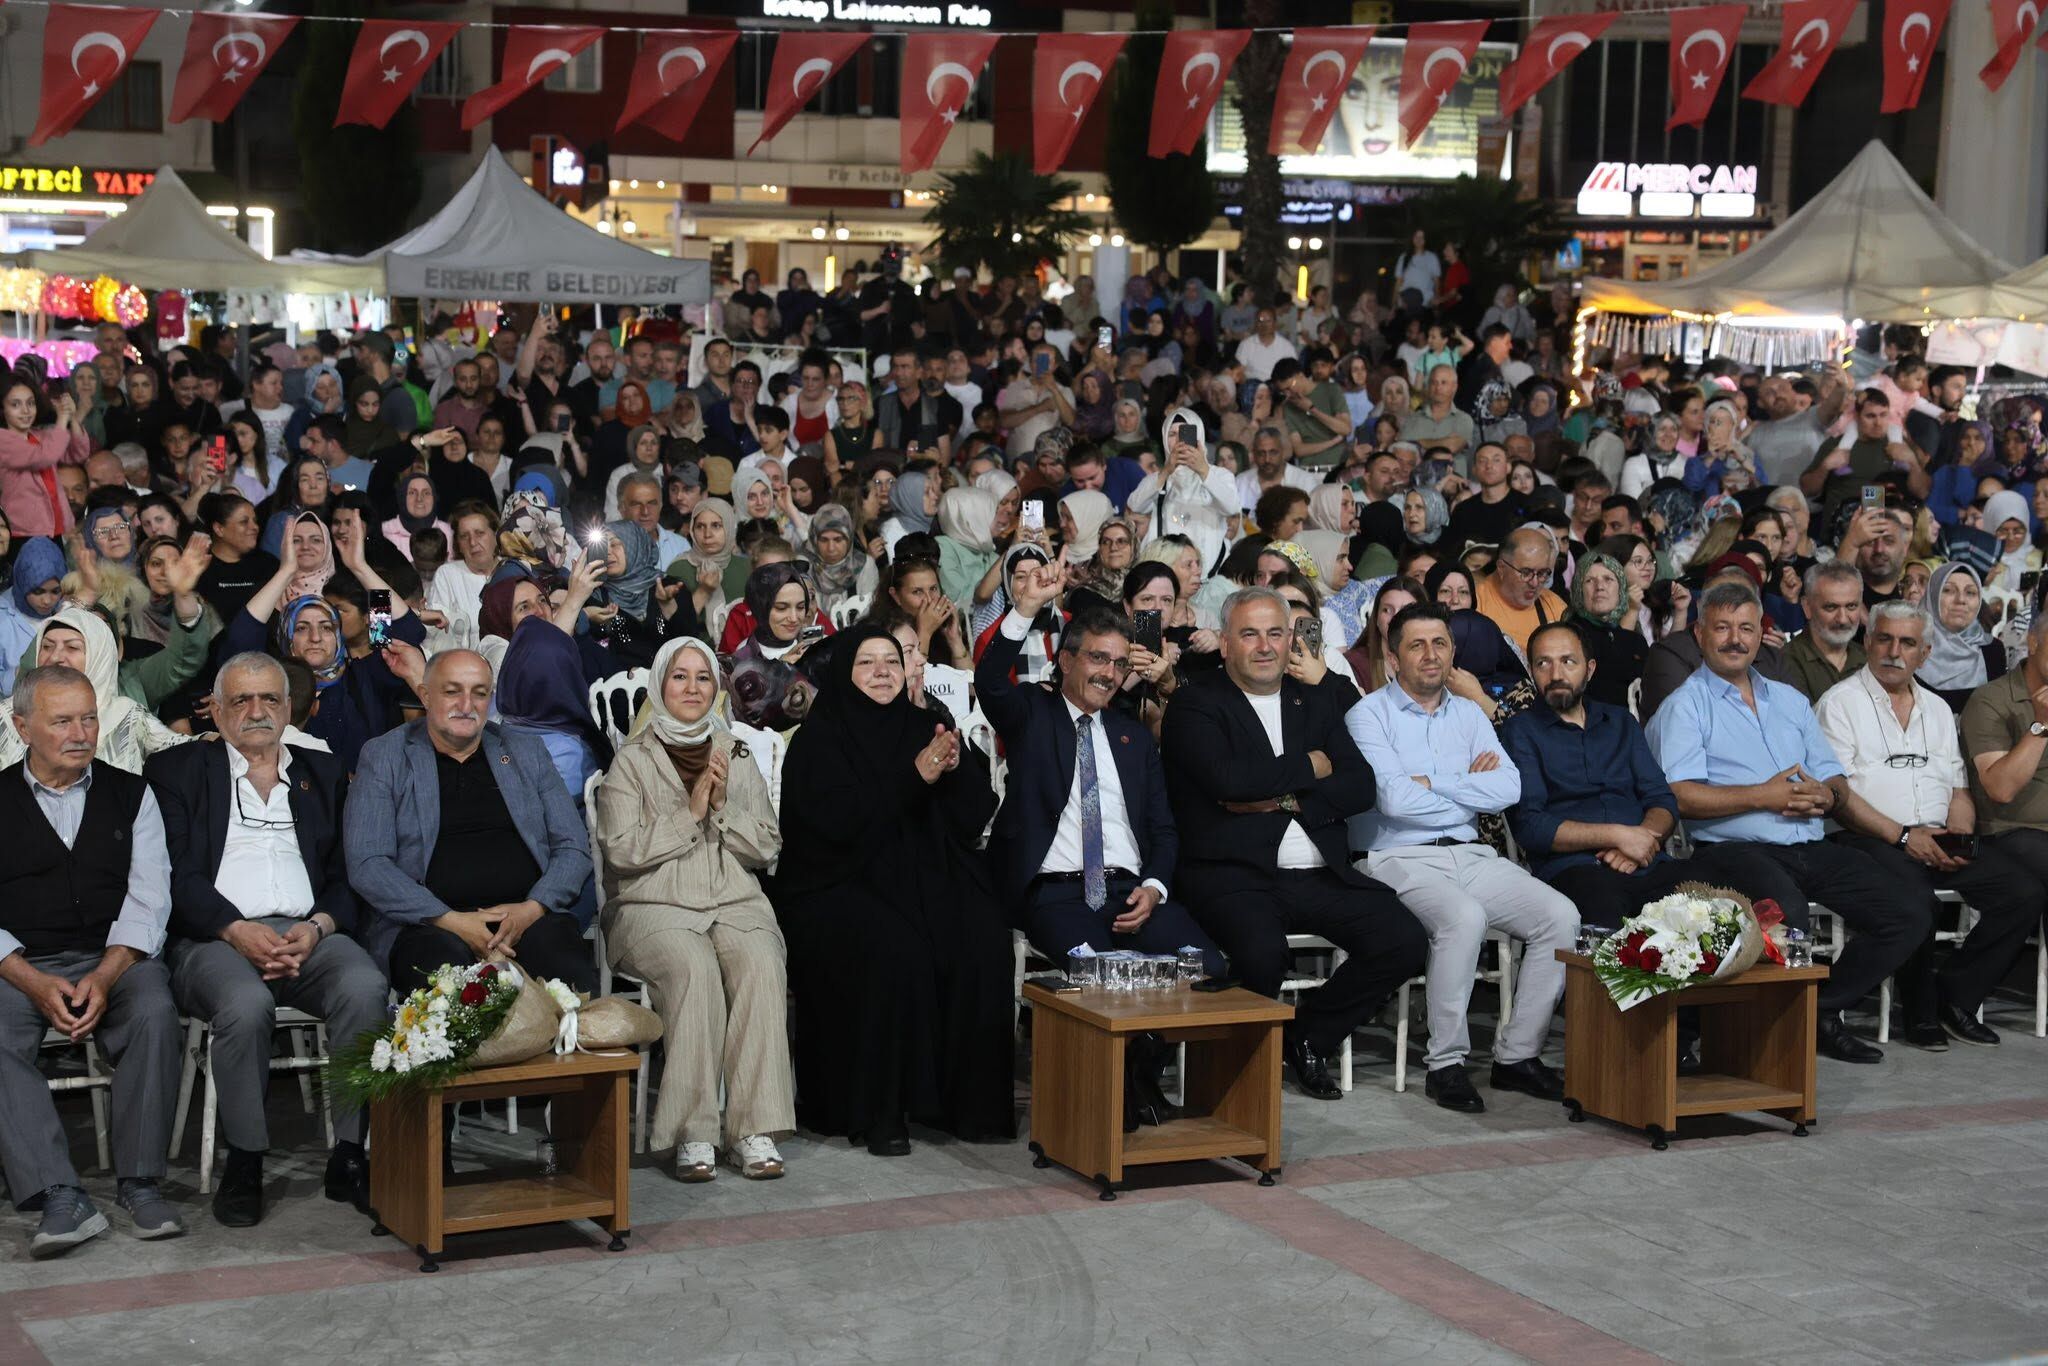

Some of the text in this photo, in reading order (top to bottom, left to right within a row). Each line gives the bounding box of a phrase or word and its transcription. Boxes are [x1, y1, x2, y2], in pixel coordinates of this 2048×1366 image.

[0, 165, 82, 193] FTECİ
[1626, 162, 1757, 194] MERCAN
[425, 268, 531, 292] ERENLER
